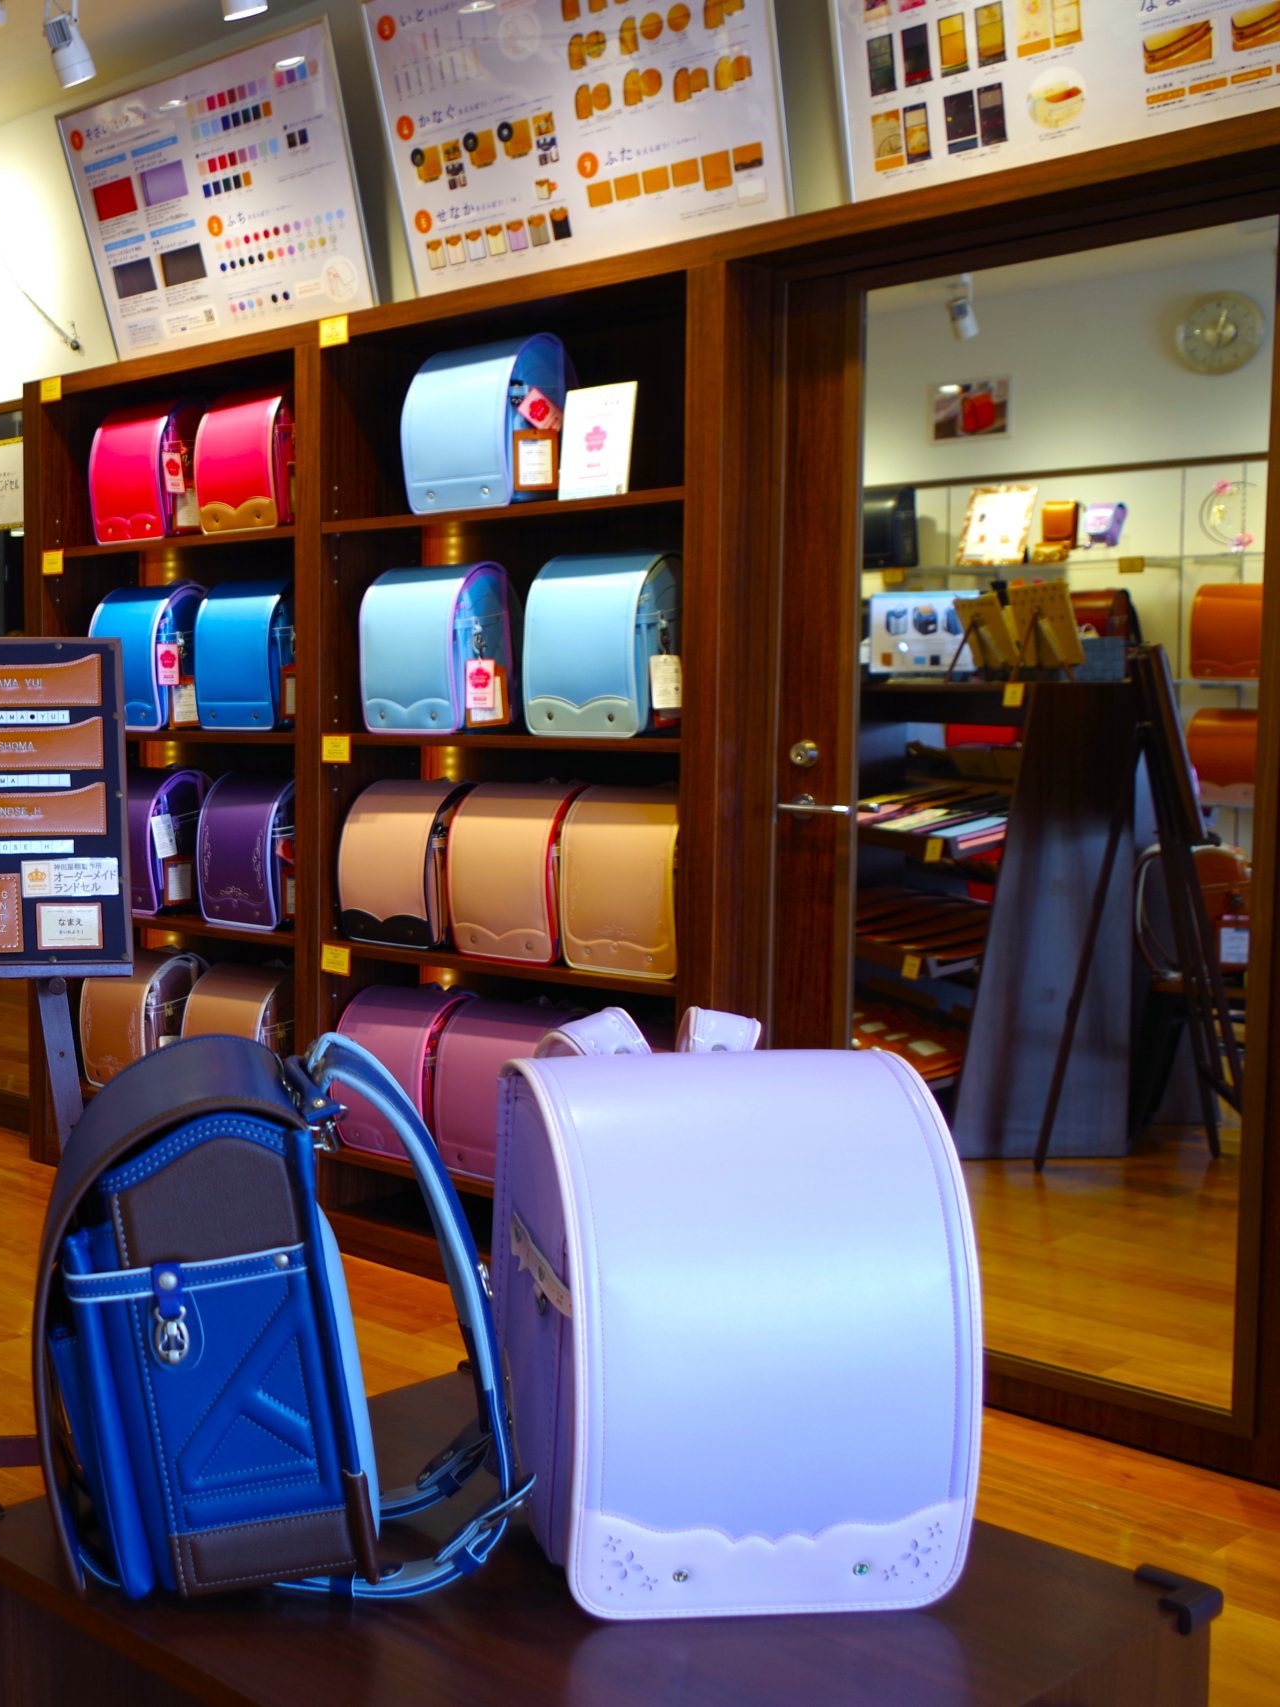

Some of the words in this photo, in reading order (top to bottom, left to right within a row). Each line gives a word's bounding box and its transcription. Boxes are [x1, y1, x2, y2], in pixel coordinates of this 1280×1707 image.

[418, 104, 456, 128] かなぐ
[25, 678, 43, 688] YUI
[54, 869, 117, 882] オーダーメイド
[54, 882, 102, 894] ランドセル
[58, 918, 83, 927] なまえ
